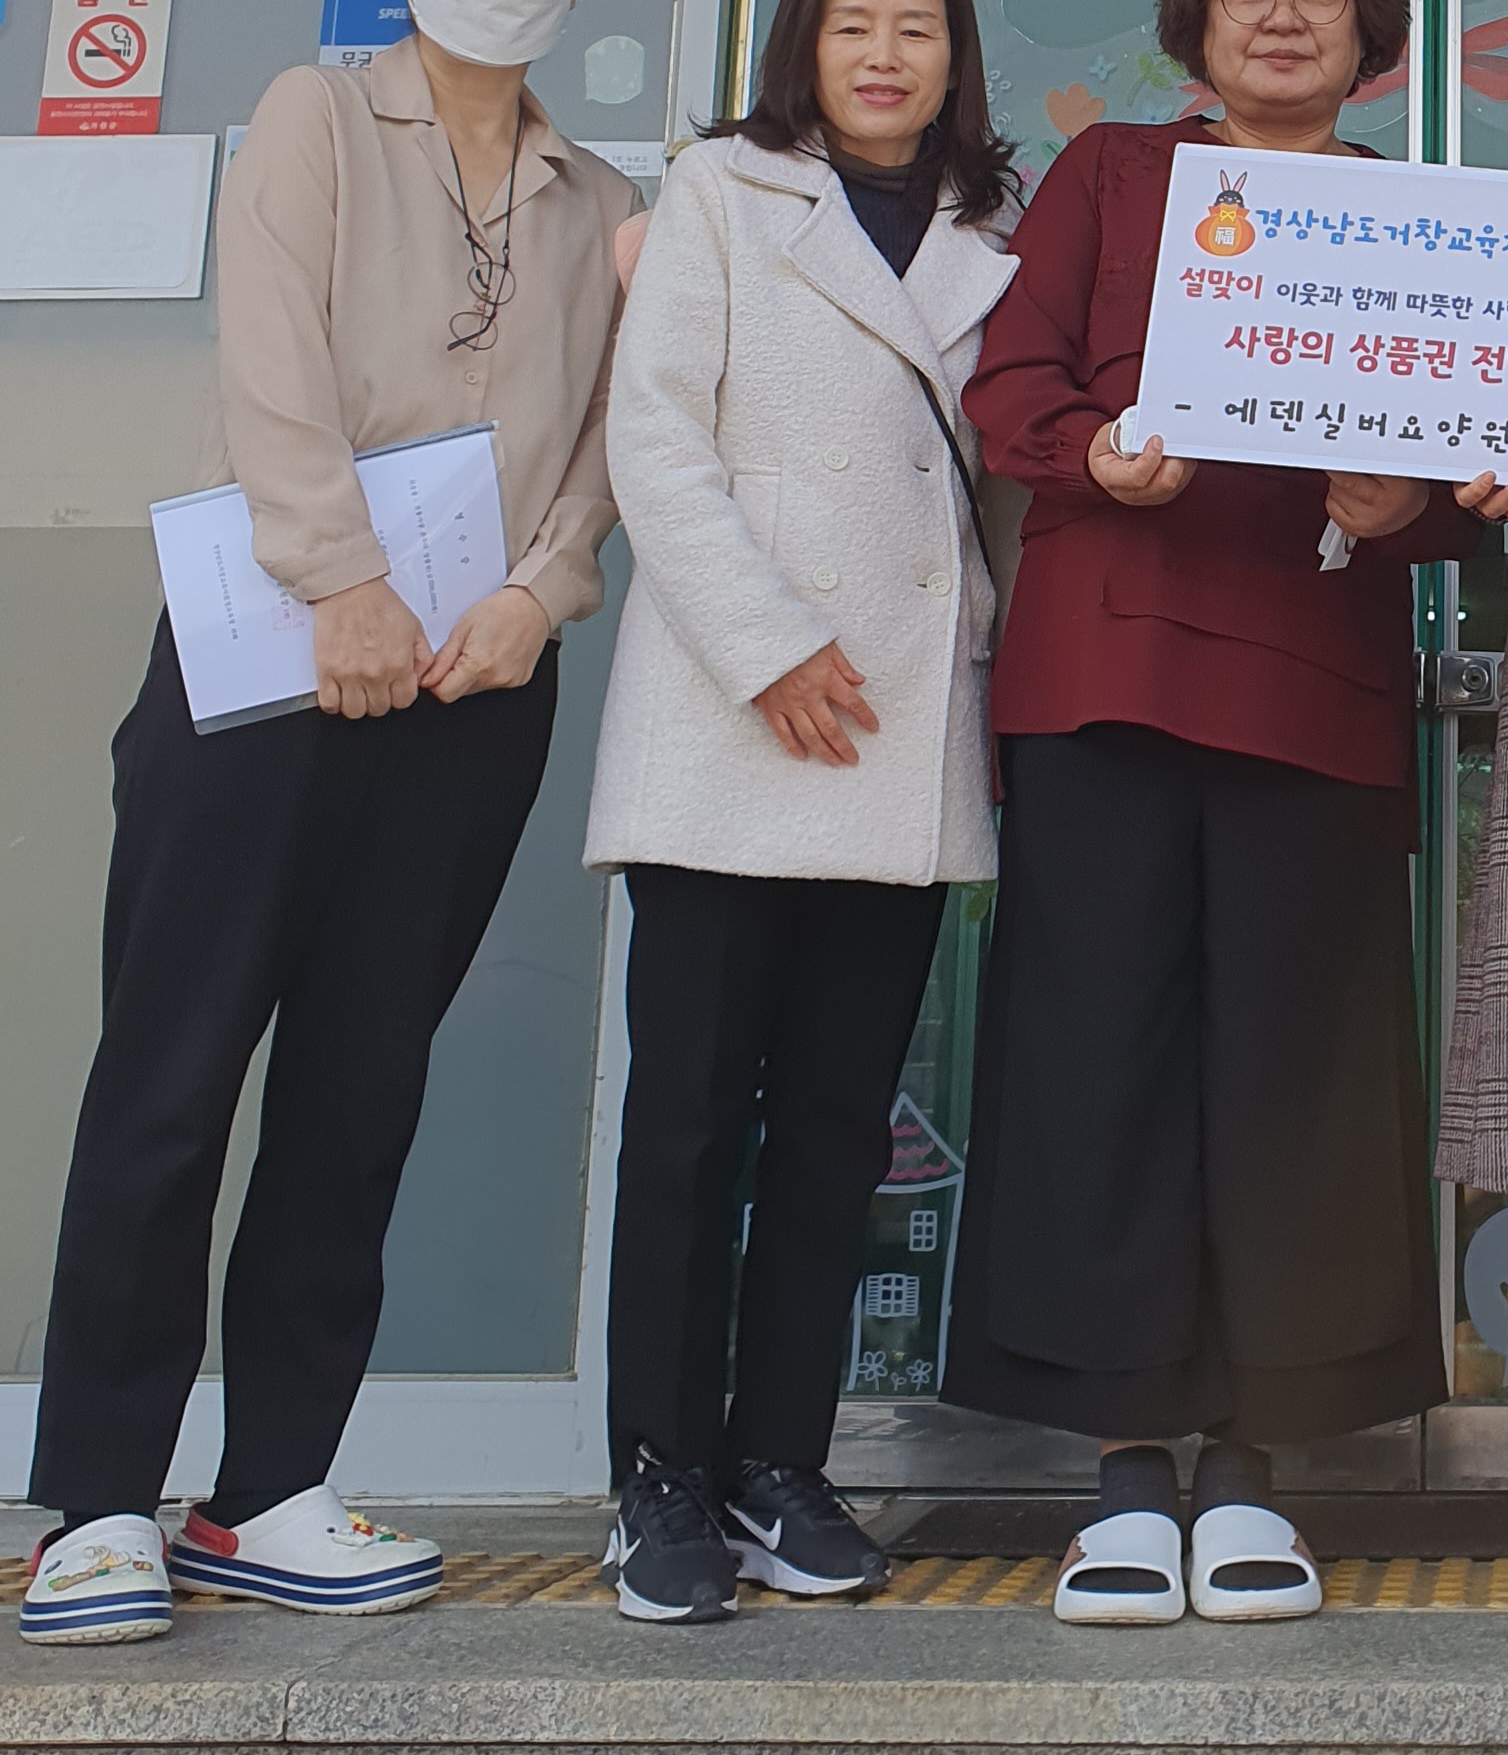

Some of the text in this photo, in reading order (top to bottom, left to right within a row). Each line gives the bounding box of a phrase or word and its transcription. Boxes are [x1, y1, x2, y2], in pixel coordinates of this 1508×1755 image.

[1180, 267, 1263, 300] 설맞이
[1276, 282, 1343, 307] 이웃과
[1351, 286, 1398, 312] 함께
[1406, 292, 1474, 320] 따뜻한
[1224, 325, 1334, 366] 사랑의
[1349, 334, 1456, 379] 상품권
